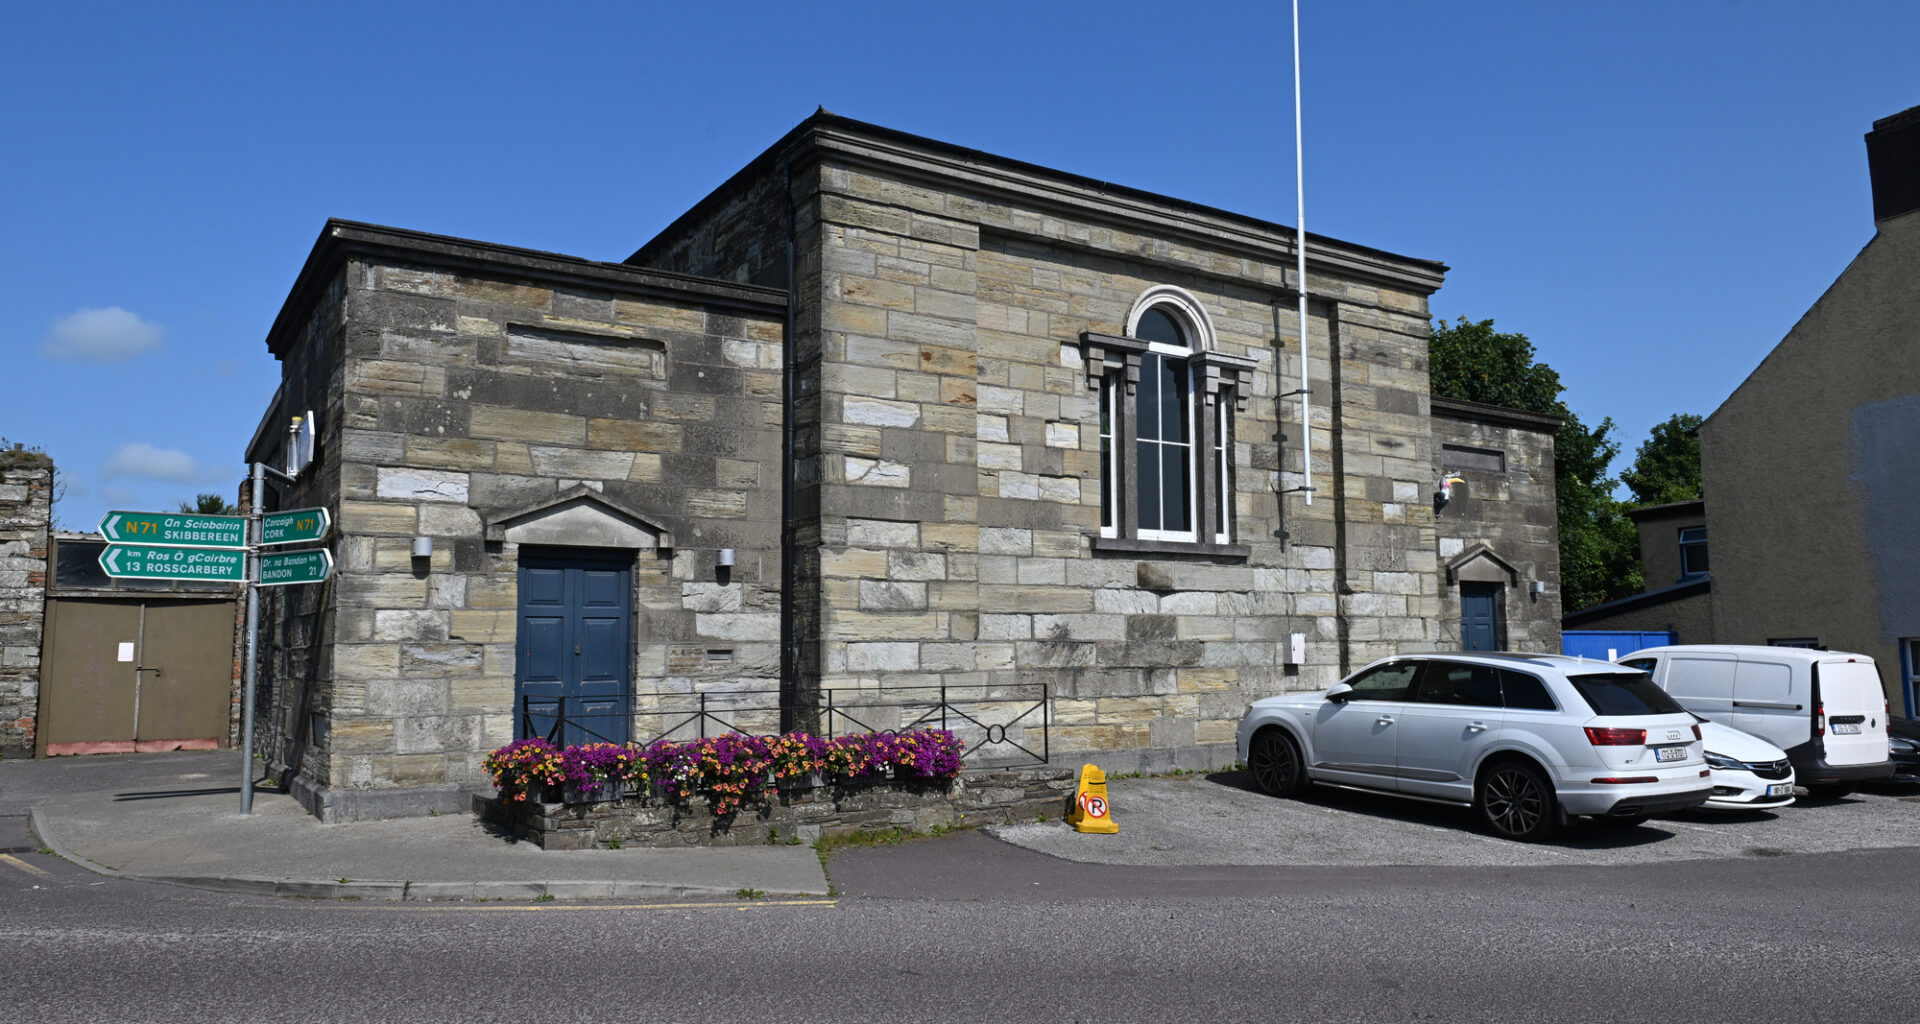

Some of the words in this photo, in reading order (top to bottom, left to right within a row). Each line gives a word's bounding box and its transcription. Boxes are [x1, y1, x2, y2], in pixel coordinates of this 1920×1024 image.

[164, 530, 239, 542] SKIBBEREEN
[264, 529, 284, 539] CORK
[127, 549, 141, 557] km
[147, 551, 170, 561] Ros
[187, 553, 237, 564] gCairbre
[126, 561, 140, 572] 13
[146, 563, 233, 575] ROSSCARBERY
[308, 566, 317, 576] 21
[262, 569, 292, 579] BANDON
